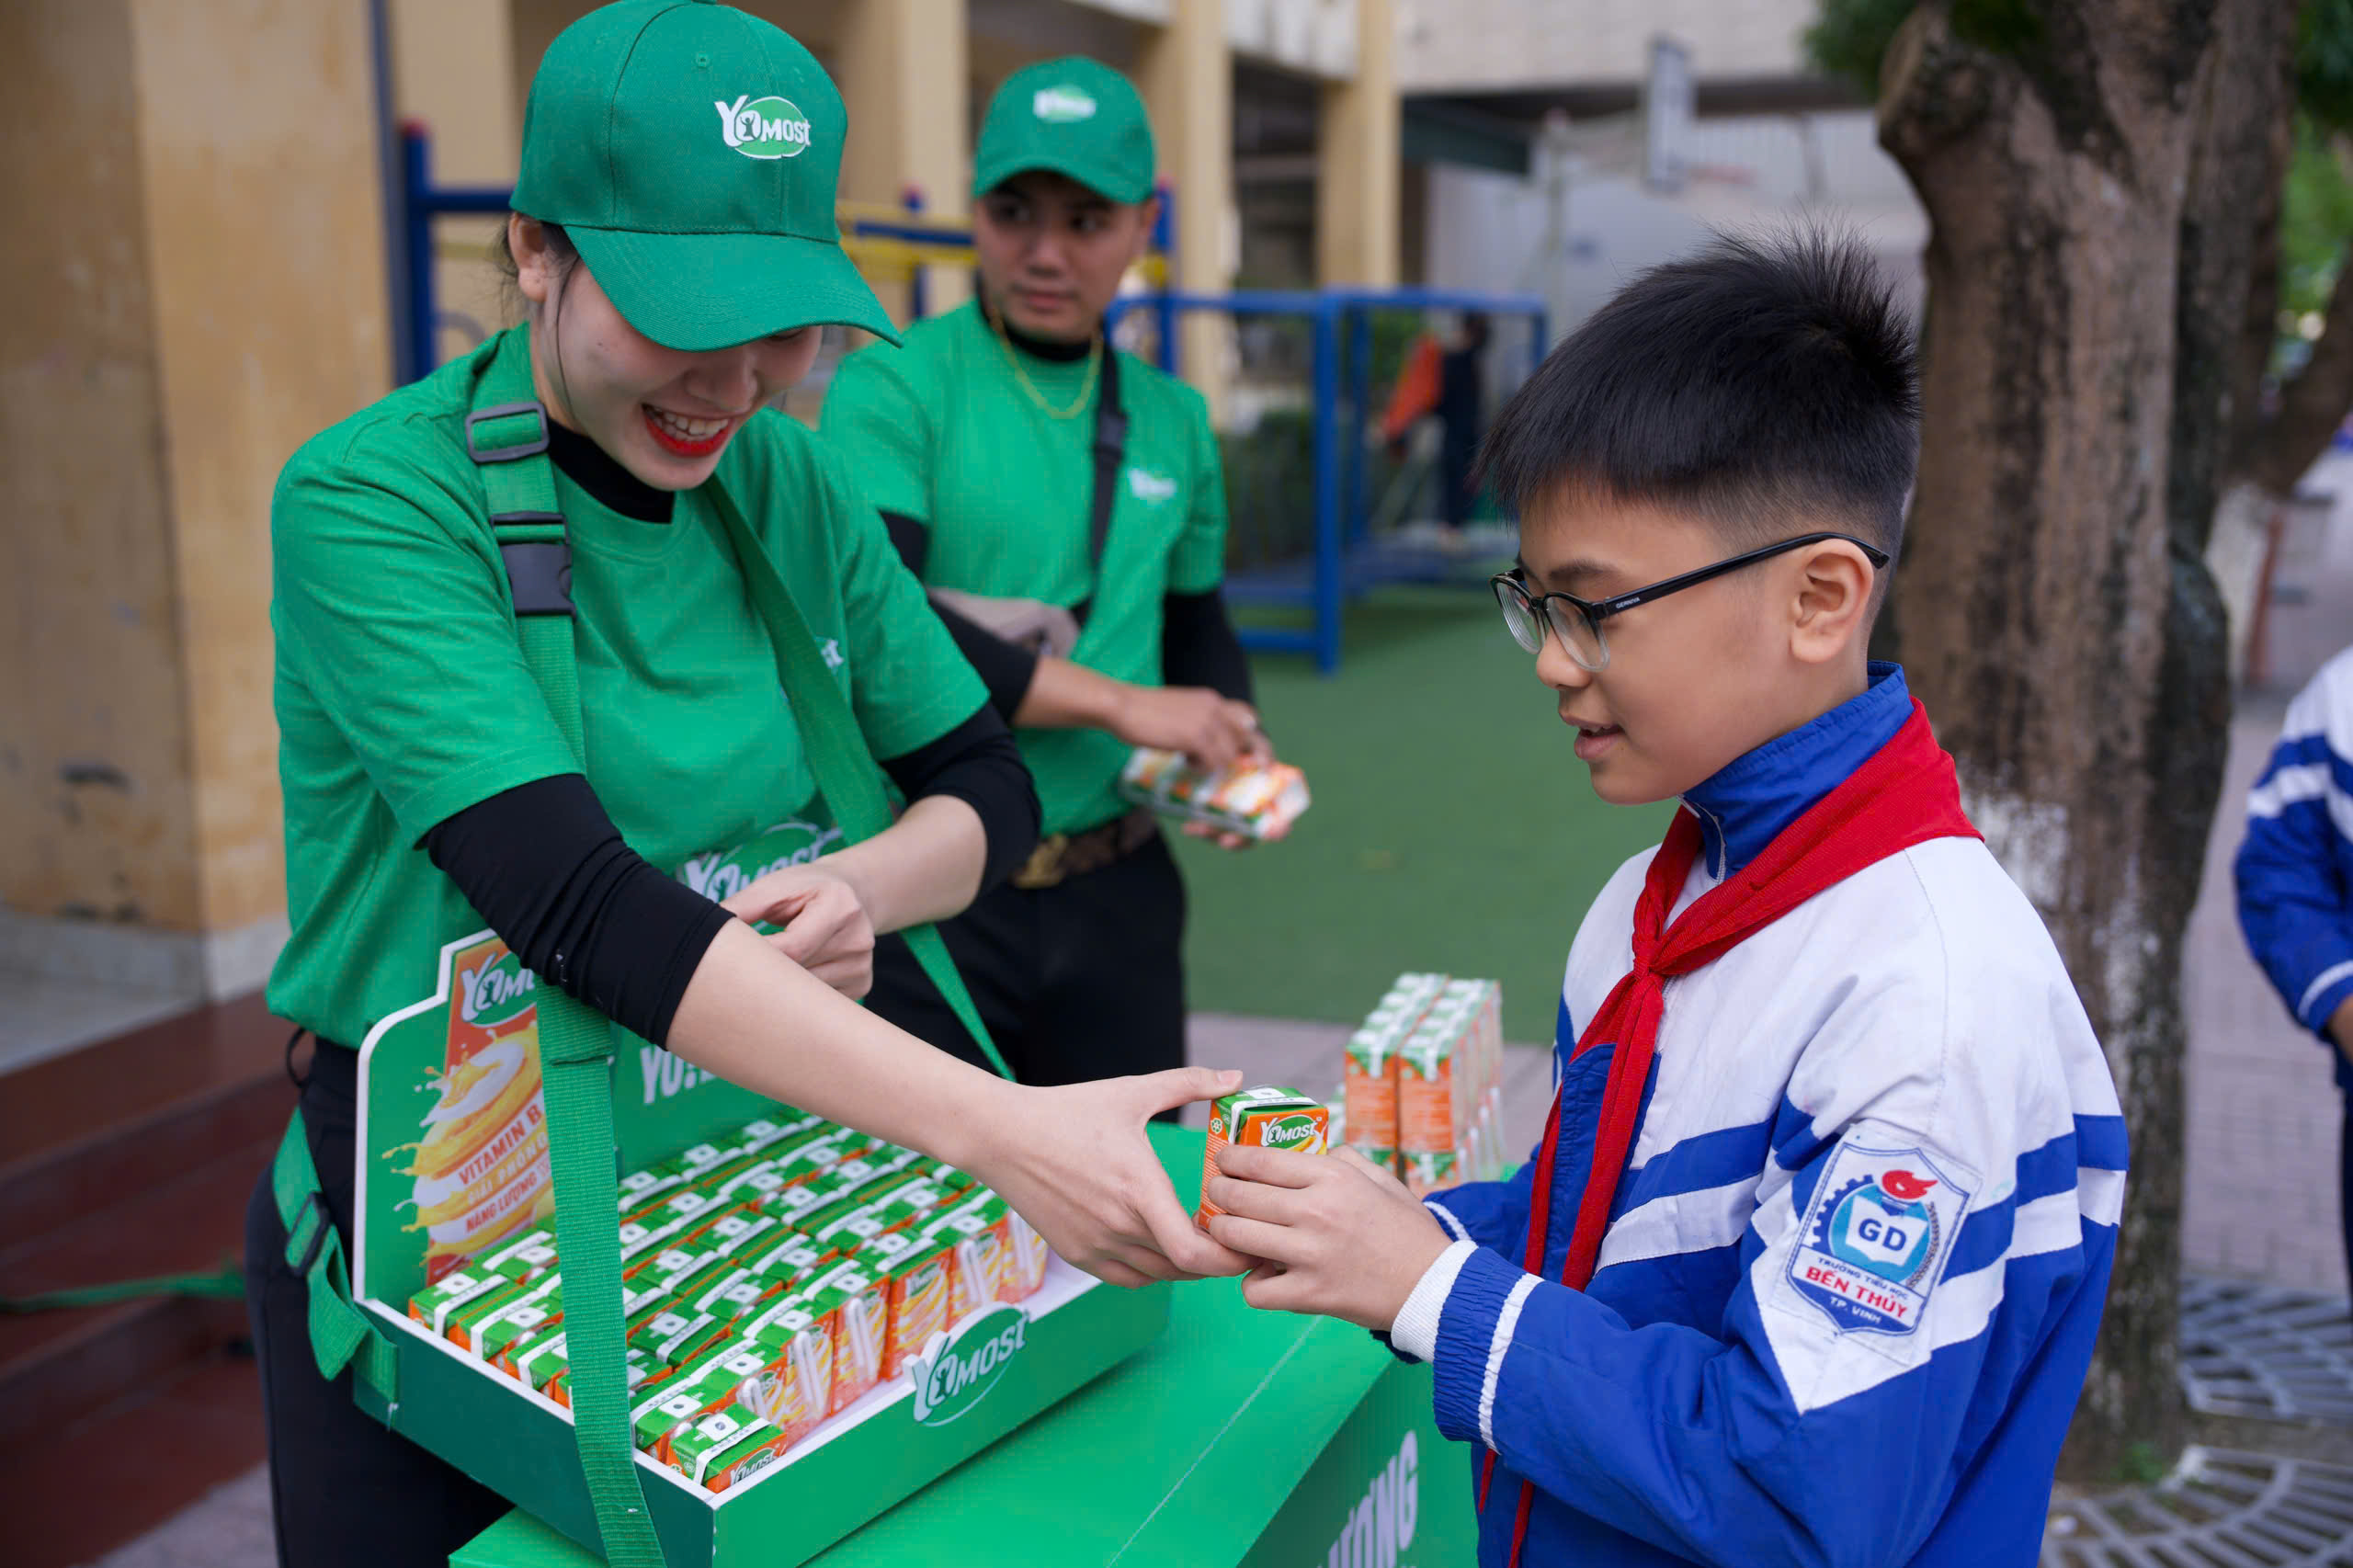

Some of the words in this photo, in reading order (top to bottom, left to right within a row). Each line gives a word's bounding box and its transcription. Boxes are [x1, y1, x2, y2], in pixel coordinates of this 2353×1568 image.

[459, 1120, 526, 1185] VITAMIN
[1858, 1218, 1907, 1251] GD
[1805, 1266, 1850, 1293] BẾN
[1852, 1305, 1882, 1324] VINH
